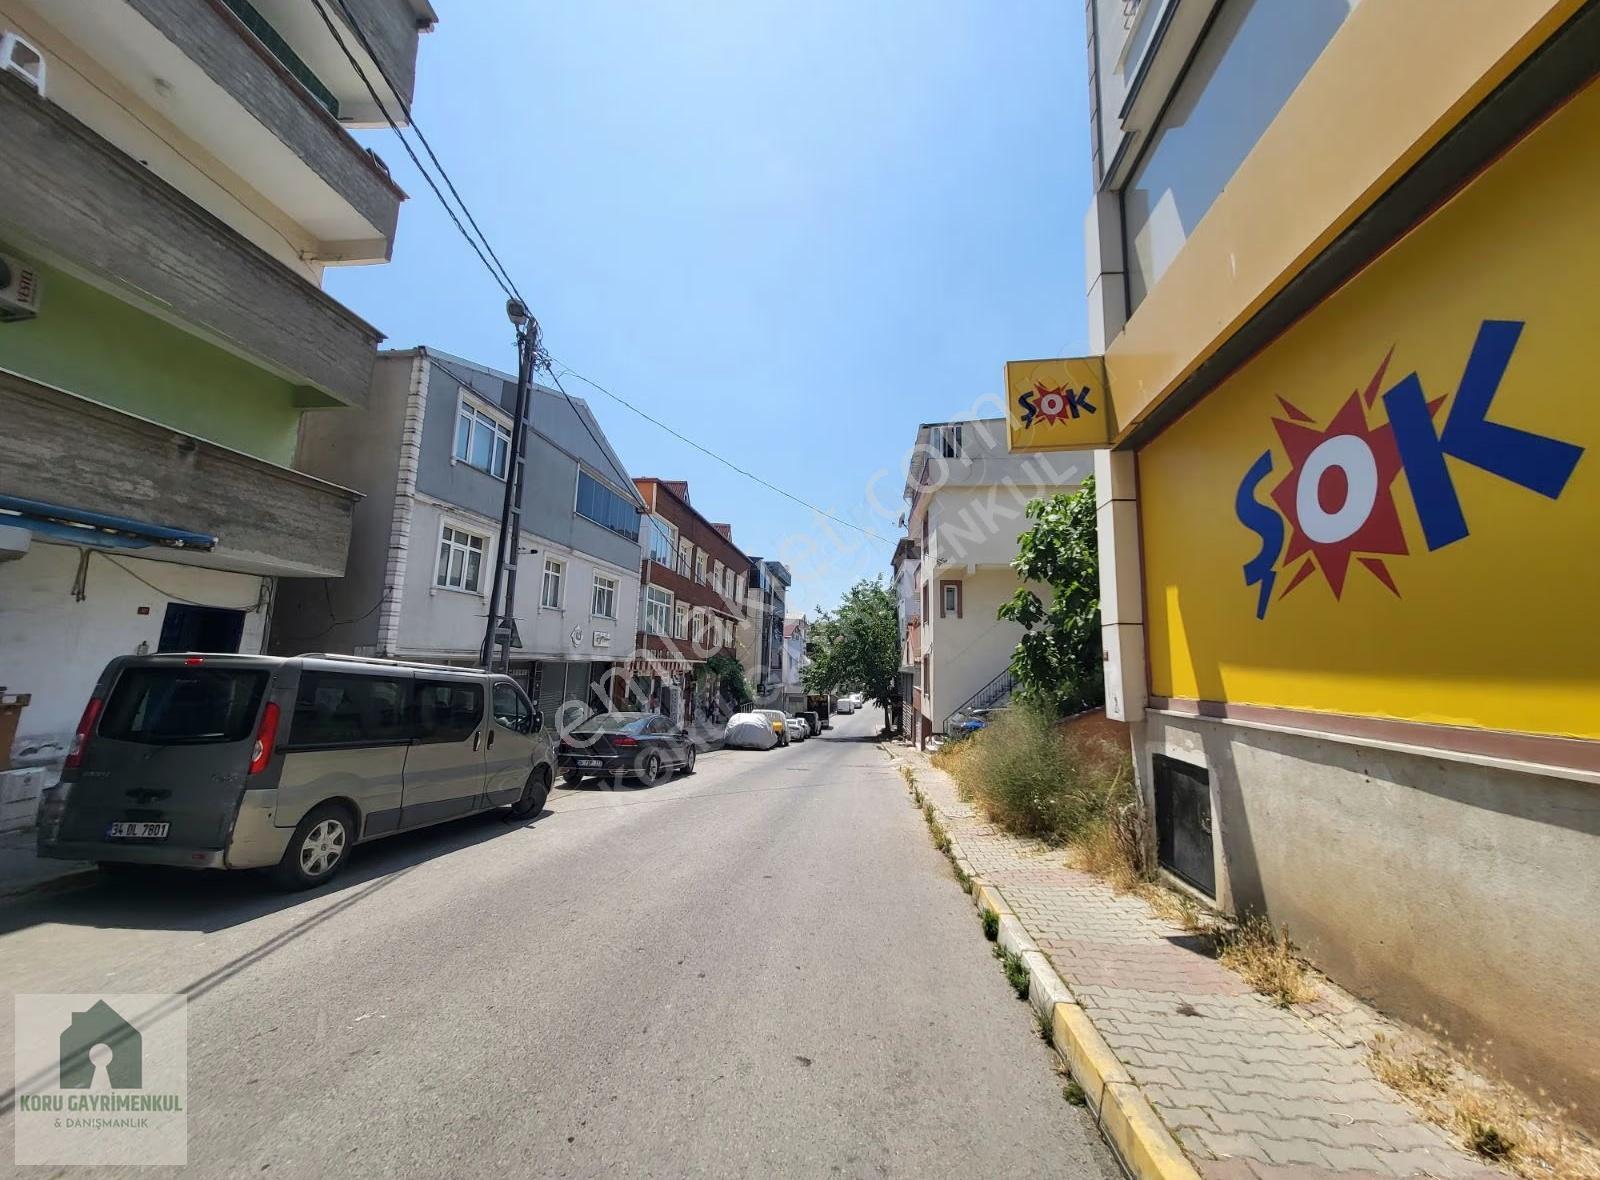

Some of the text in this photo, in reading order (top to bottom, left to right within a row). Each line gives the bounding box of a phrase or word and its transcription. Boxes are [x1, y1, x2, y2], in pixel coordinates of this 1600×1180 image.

[1018, 386, 1097, 429] ŞOK
[1236, 320, 1584, 620] ŞOK
[112, 823, 167, 837] 34 DL 7801
